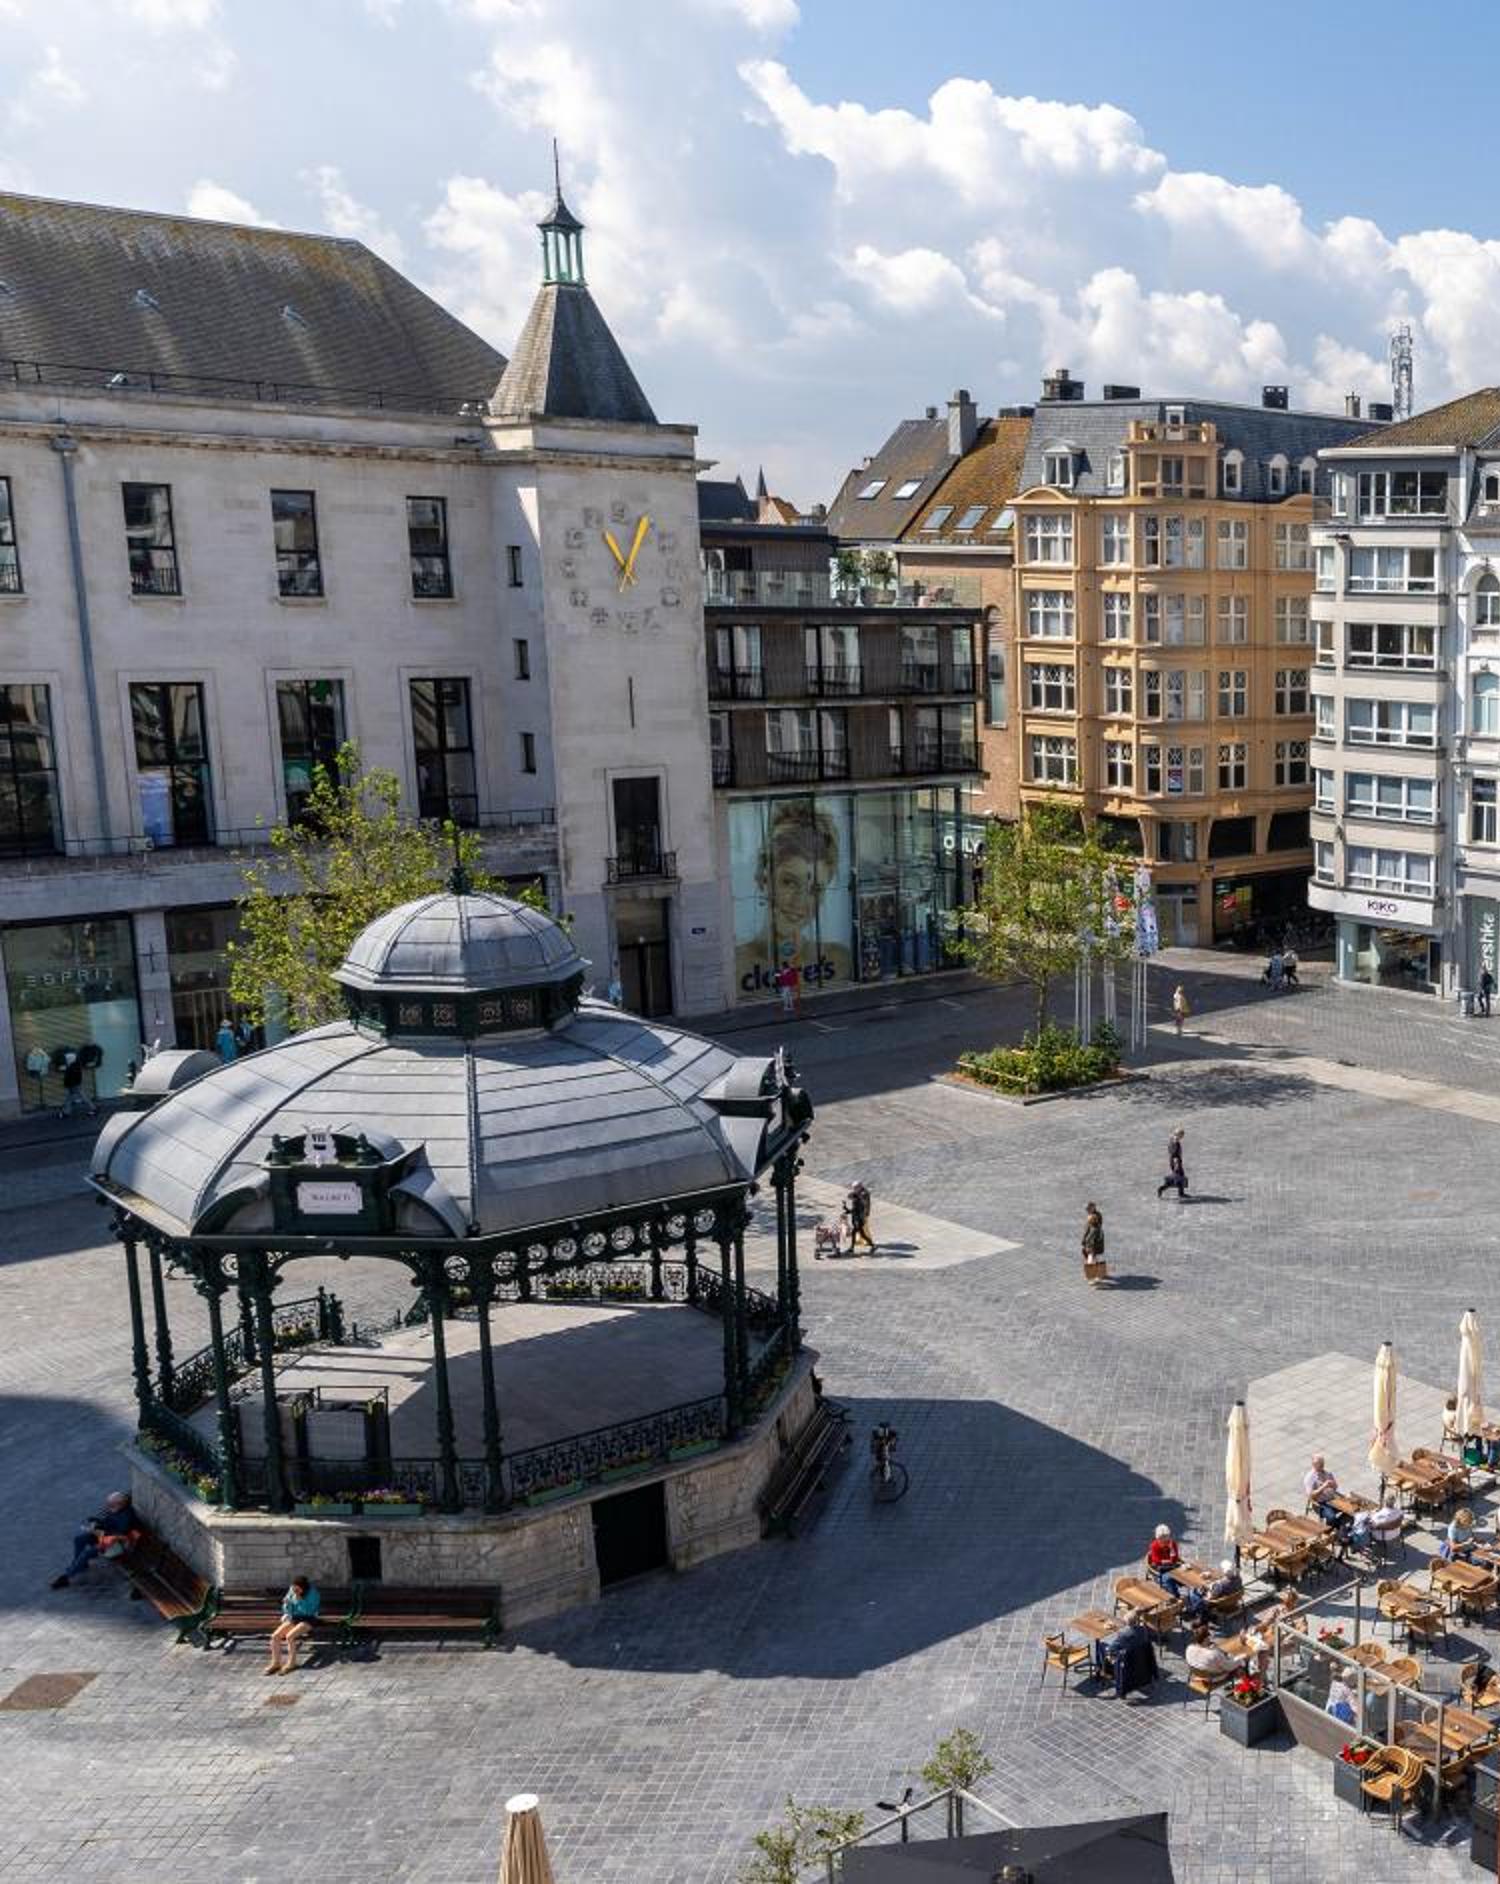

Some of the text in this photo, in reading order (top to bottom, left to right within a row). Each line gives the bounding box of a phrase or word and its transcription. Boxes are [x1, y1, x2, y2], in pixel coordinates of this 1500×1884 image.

[1367, 899, 1398, 913] KIKO
[1480, 911, 1495, 976] ershka
[25, 967, 114, 987] ESPRIT
